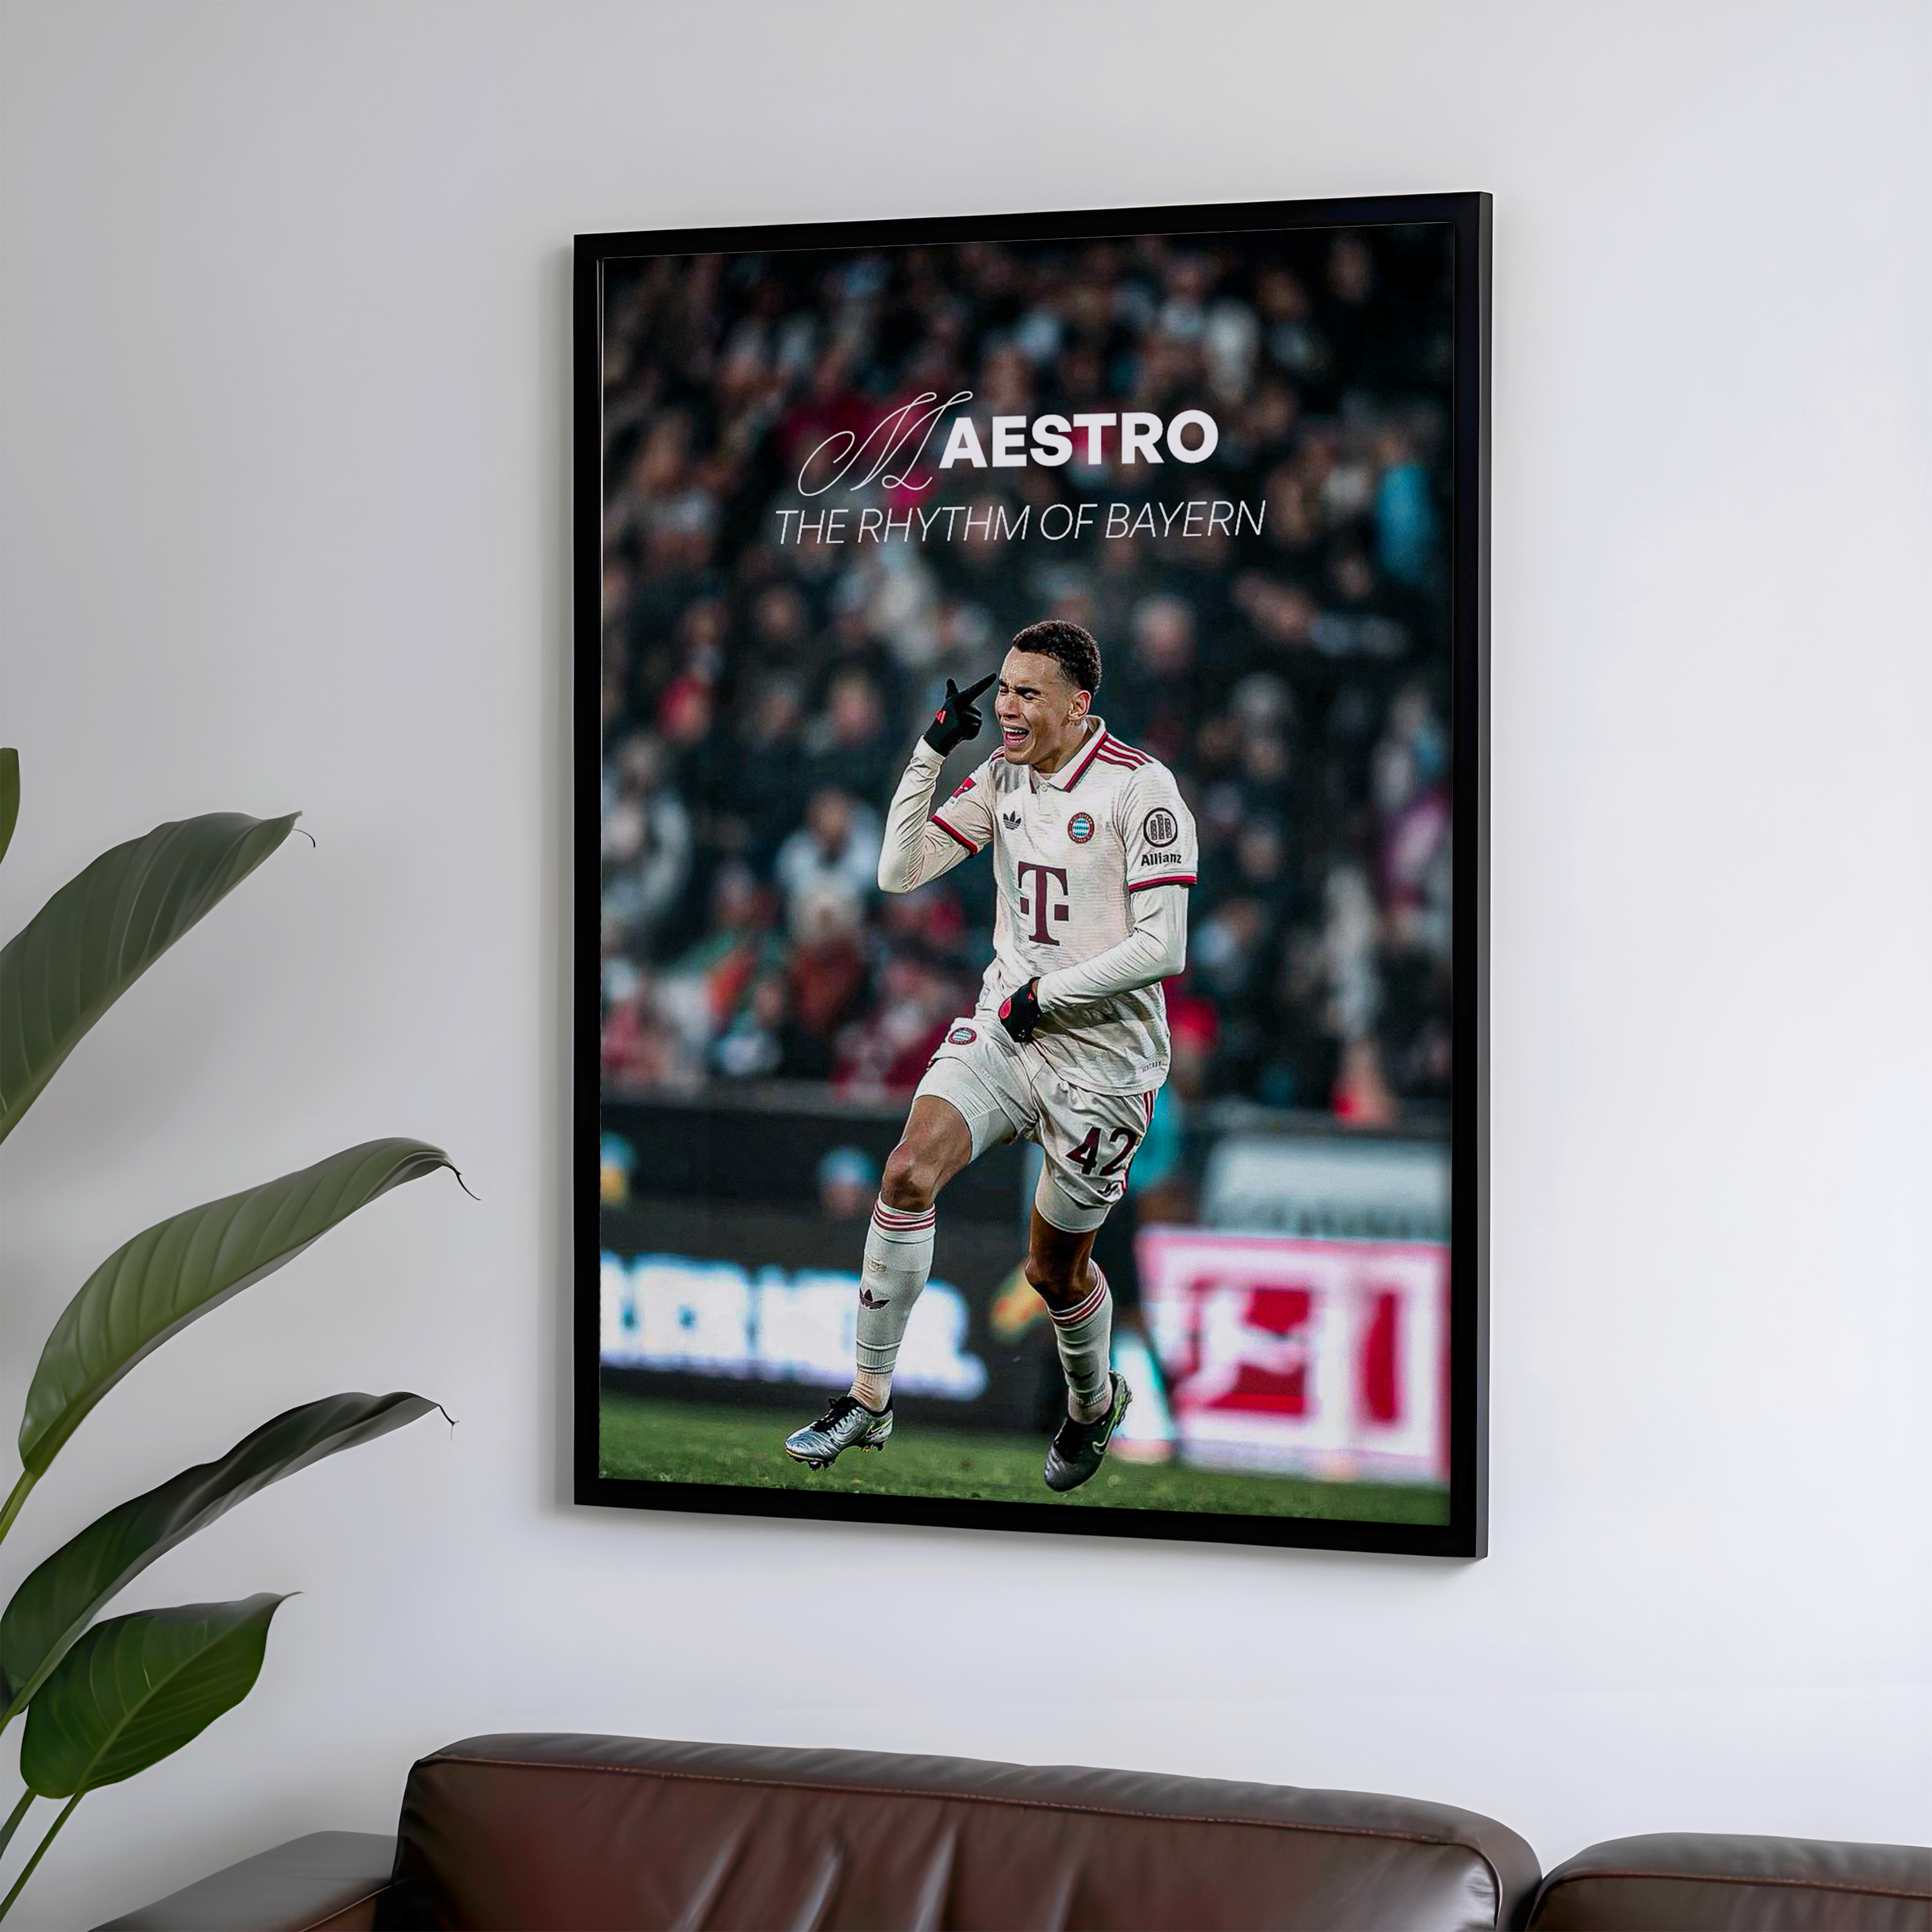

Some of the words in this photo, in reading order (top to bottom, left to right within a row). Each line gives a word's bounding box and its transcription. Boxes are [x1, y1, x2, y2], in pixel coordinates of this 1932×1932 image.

[797, 390, 1219, 497] MAESTRO
[775, 509, 849, 545] THE
[857, 504, 1031, 544] RHYTHM
[1039, 503, 1099, 541] OF
[1104, 499, 1267, 539] BAYERN
[1141, 852, 1182, 866] Allianz
[1065, 1126, 1137, 1177] 42
